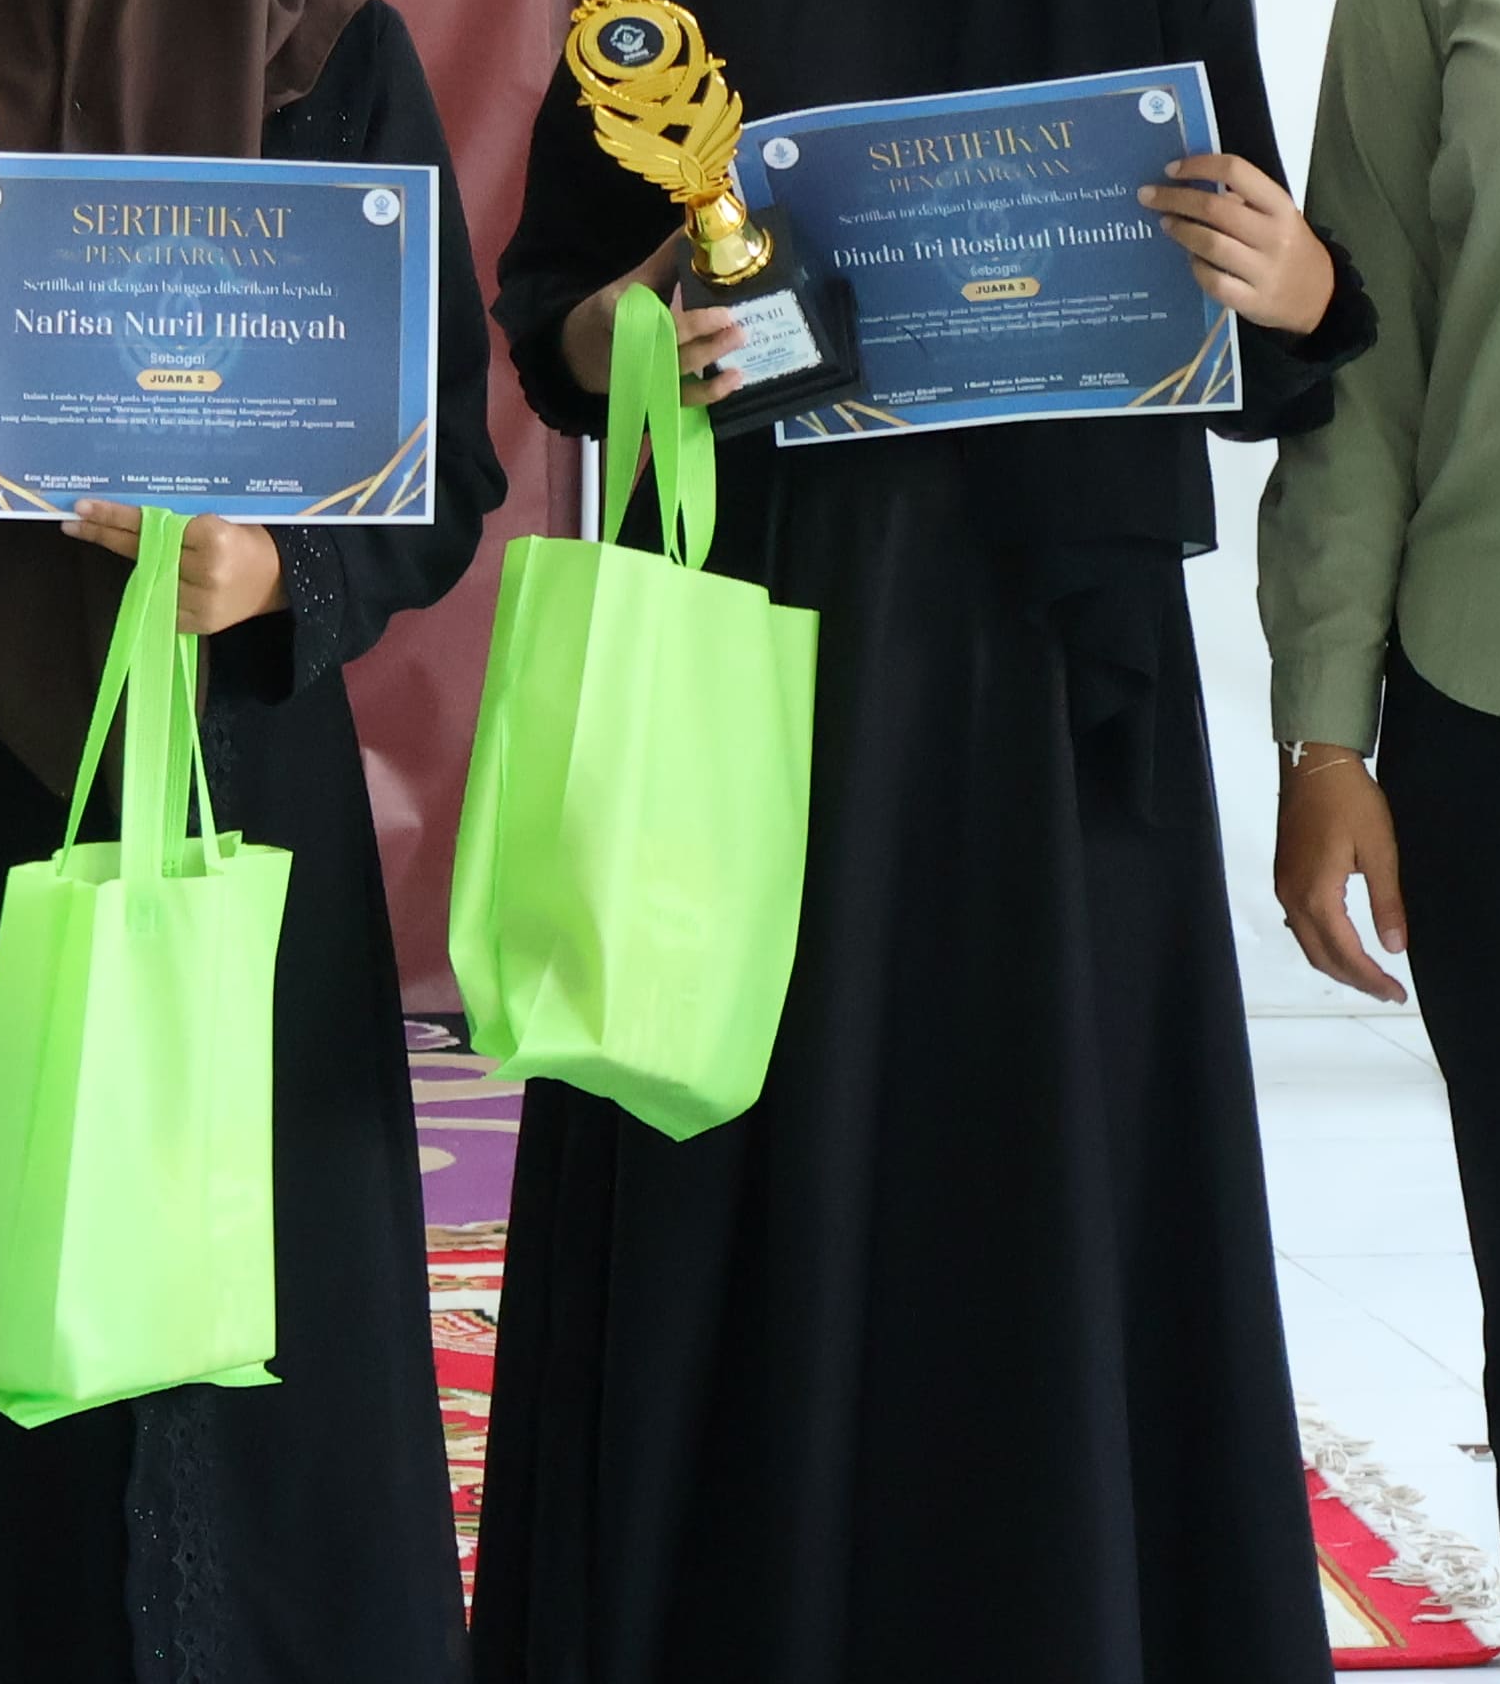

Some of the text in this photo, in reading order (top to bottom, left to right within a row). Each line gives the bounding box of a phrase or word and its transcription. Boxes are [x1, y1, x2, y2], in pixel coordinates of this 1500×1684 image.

[869, 121, 1074, 173] SERTIFIKAT
[889, 159, 1071, 195] PENGHARGAAN
[72, 203, 292, 240] SERTIFIKAT
[834, 245, 905, 268] Dinda
[912, 237, 944, 260] Tri
[1057, 219, 1153, 246] Hanifah
[86, 244, 278, 268] PENGHARGAAN
[971, 261, 1022, 278] Sebagai
[23, 278, 332, 299] Sertifikat ini dengan bangga diberikan kepada
[975, 282, 1026, 295] JUARA 3
[14, 308, 346, 343] Nafisa Nuril Hidayah
[150, 352, 205, 367] Sebagai
[150, 374, 205, 385] JUARA 2
